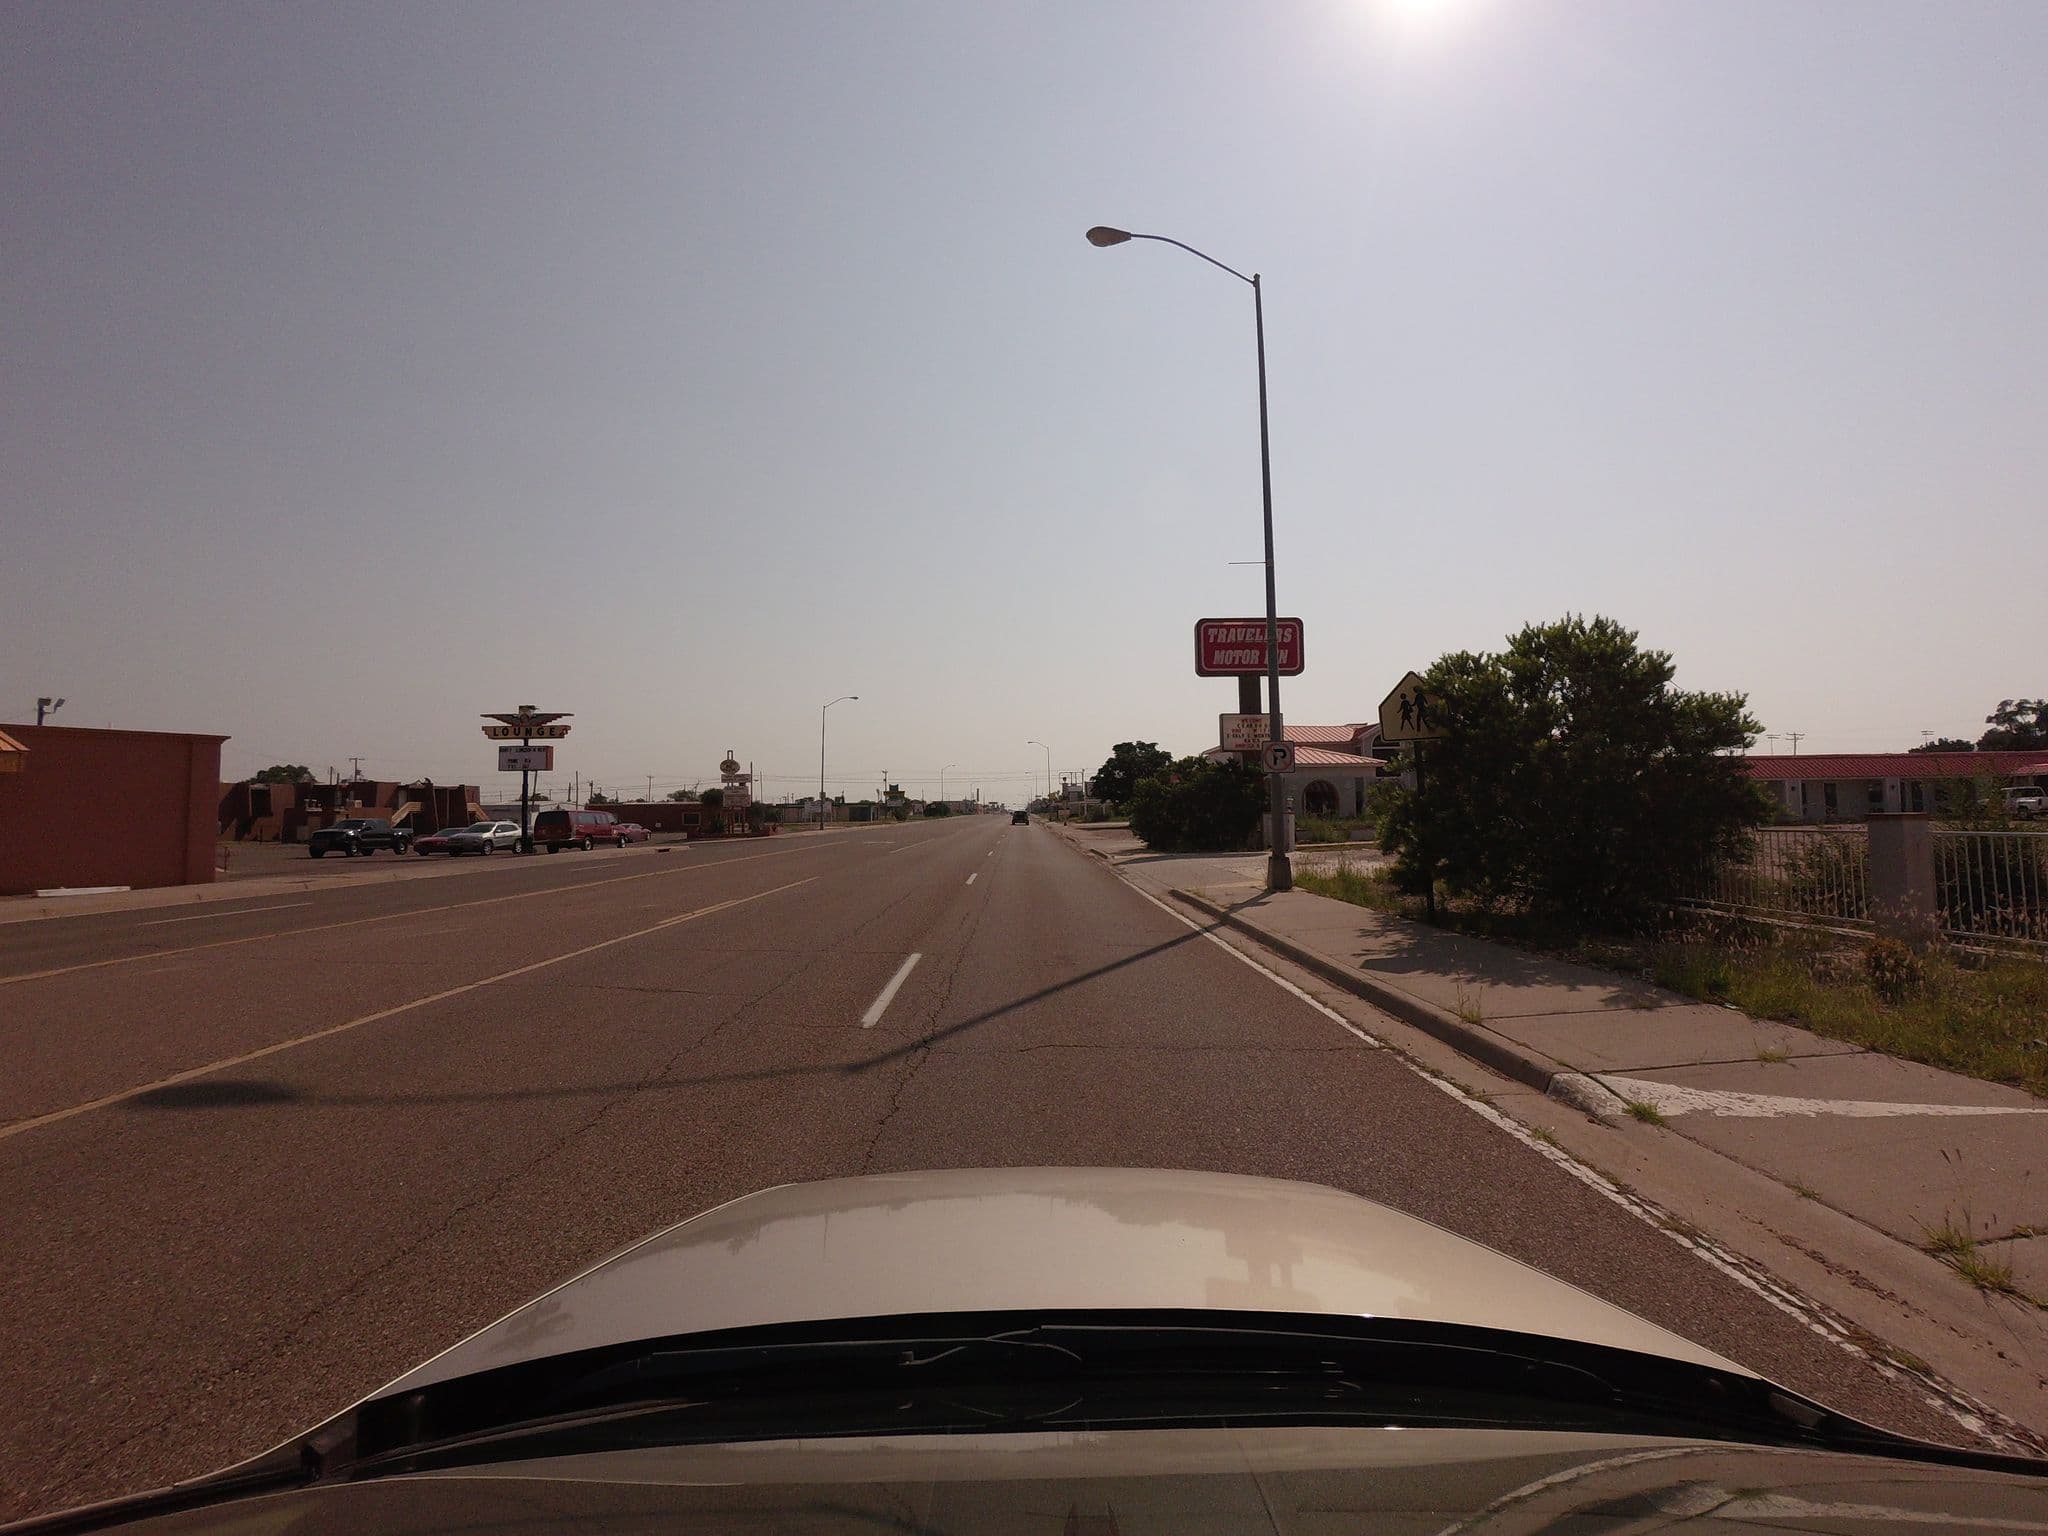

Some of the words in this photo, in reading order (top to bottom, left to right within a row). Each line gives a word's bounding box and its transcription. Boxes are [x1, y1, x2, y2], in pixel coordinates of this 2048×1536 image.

[1208, 628, 1292, 643] TRAVELRS
[1213, 649, 1260, 665] MOTOR
[493, 727, 556, 736] LOUNGE
